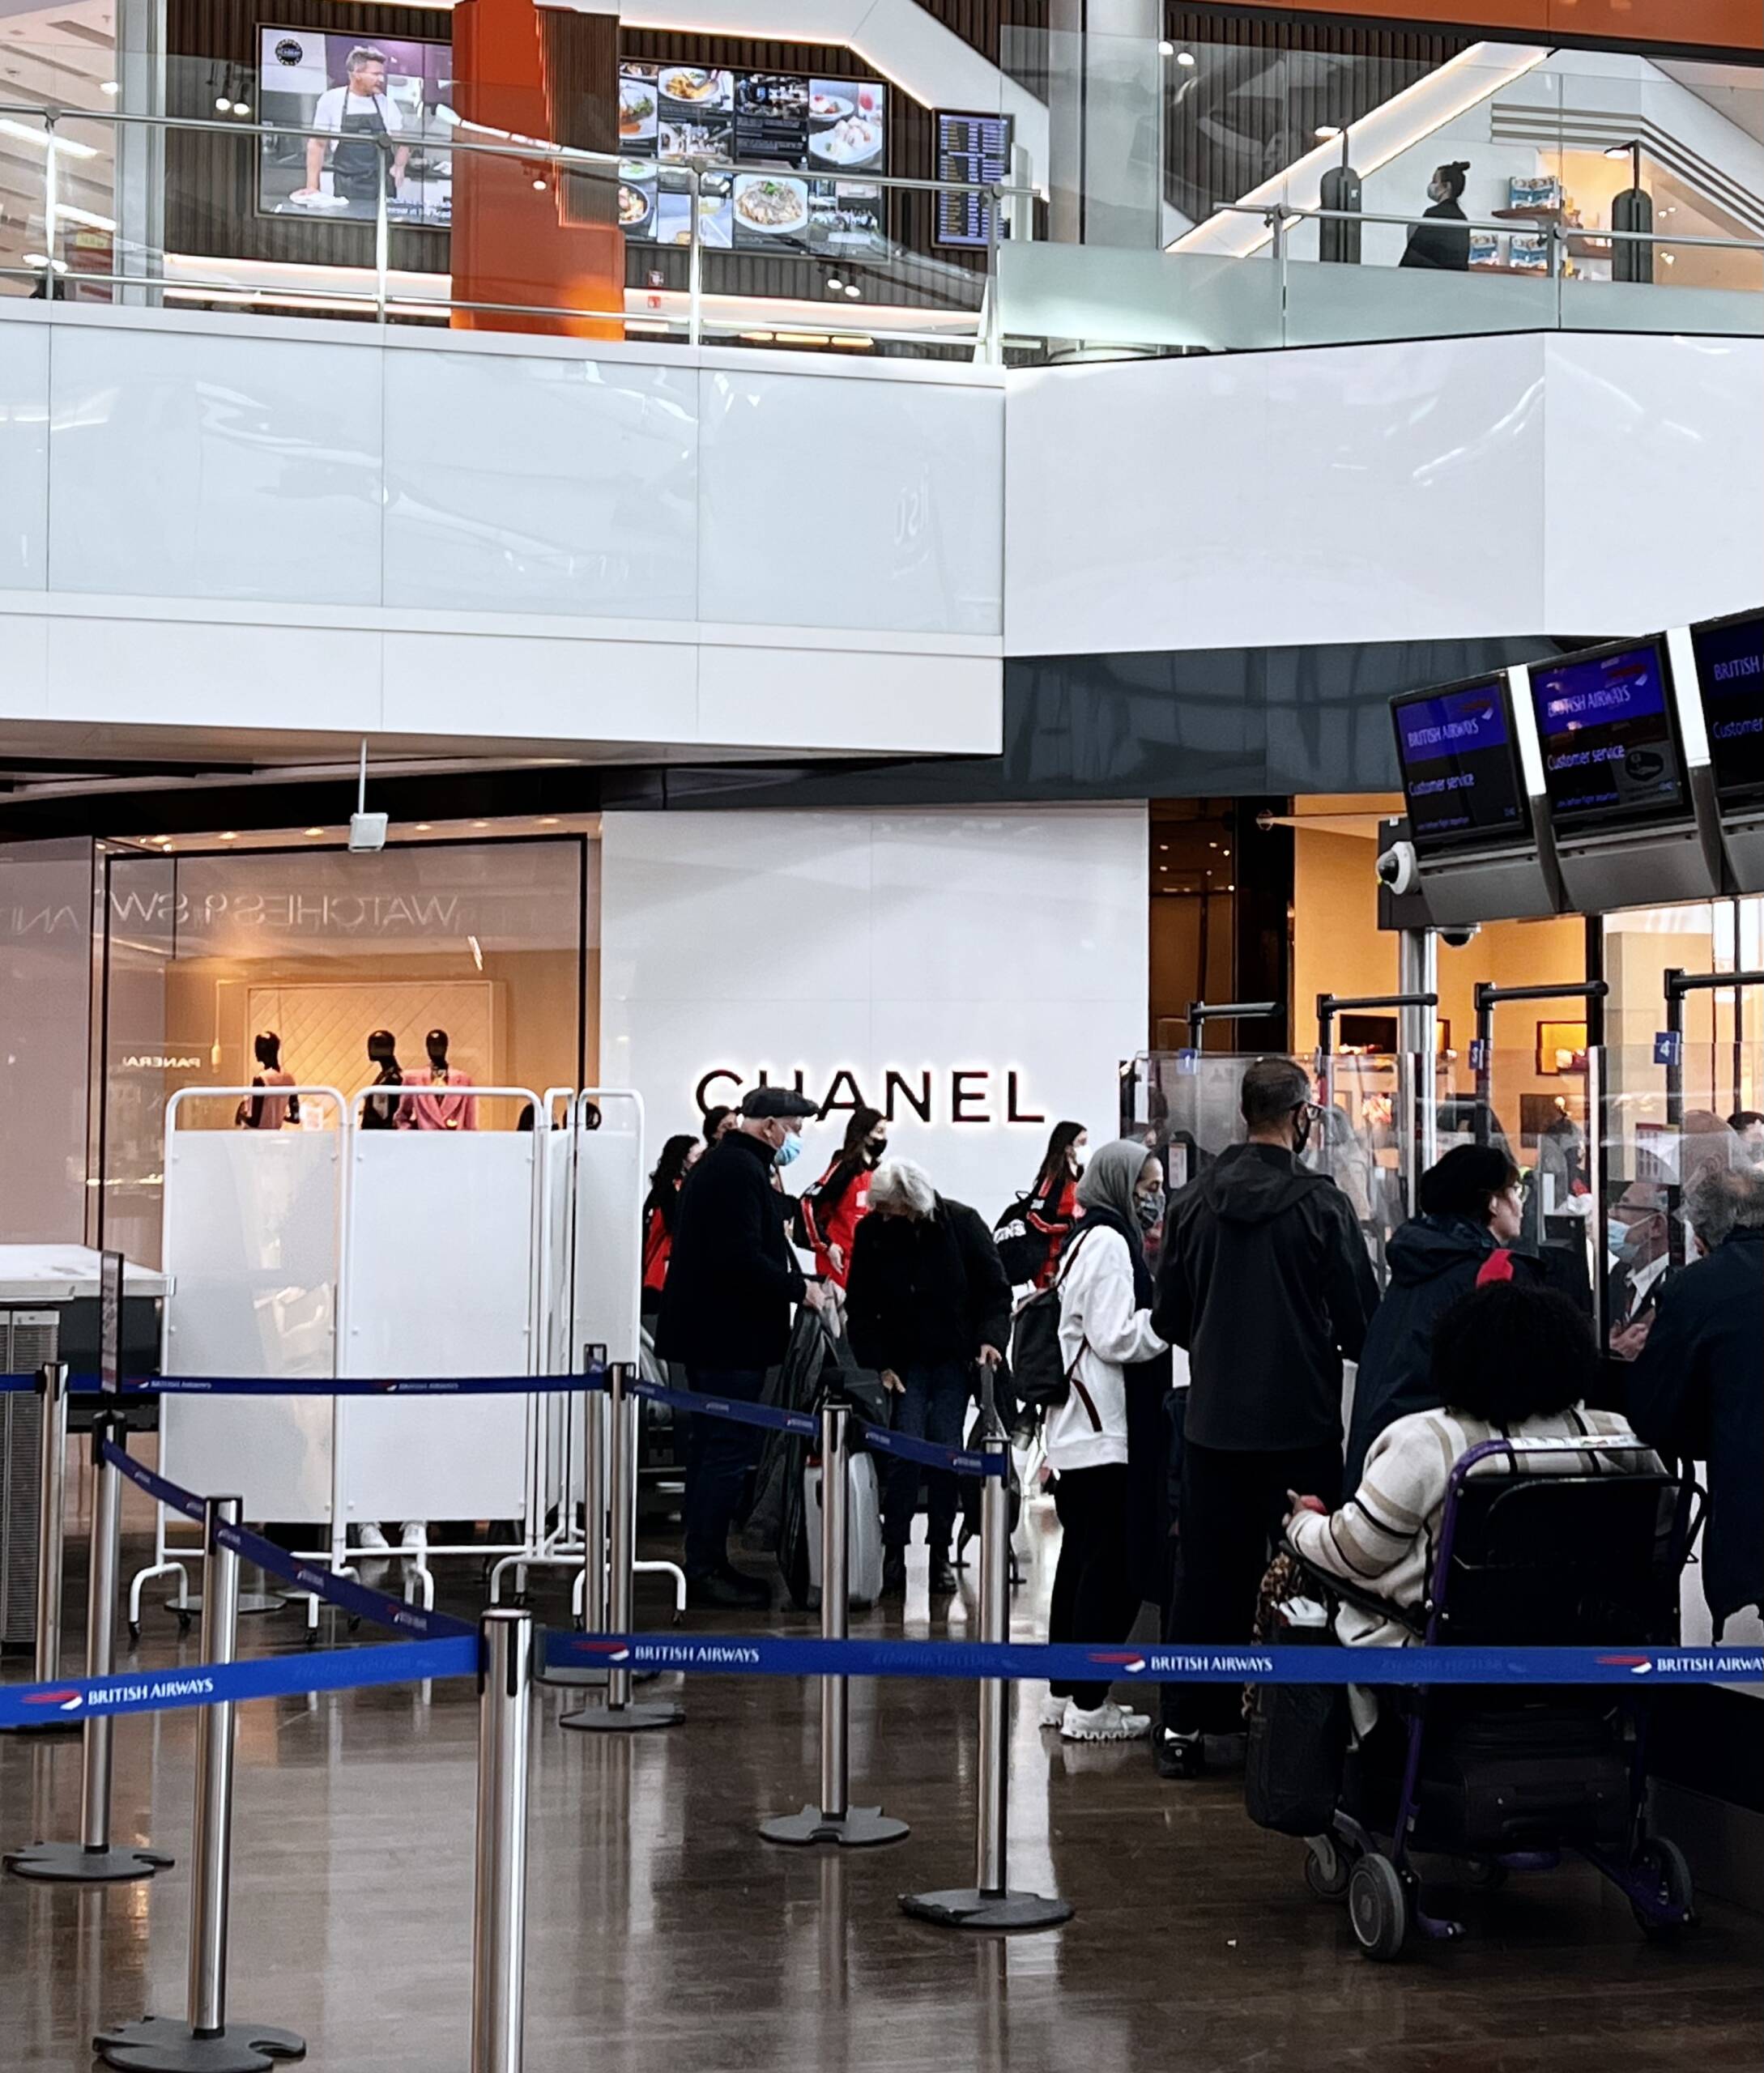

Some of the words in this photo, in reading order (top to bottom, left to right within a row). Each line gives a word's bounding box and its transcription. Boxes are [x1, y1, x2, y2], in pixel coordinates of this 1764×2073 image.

[1714, 655, 1760, 680] BRITISH
[1588, 684, 1630, 709] AIRWAYS
[1407, 726, 1442, 747] BRITISH
[1713, 717, 1763, 739] Customer
[1548, 751, 1590, 771] Customer
[1592, 743, 1626, 763] service
[1408, 779, 1445, 797] Customer
[1447, 772, 1475, 790] service
[1660, 1040, 1670, 1057] 4
[1185, 1054, 1191, 1068] 1
[635, 1645, 694, 1662] BRITISH
[696, 1646, 760, 1662] AIRWAYS
[1151, 1656, 1208, 1671] BRITISH
[1211, 1656, 1273, 1671] AIRWAYS
[1657, 1657, 1714, 1671] BRITISH
[87, 1685, 148, 1705] BRITISH
[150, 1677, 214, 1700] AIRWAYS
